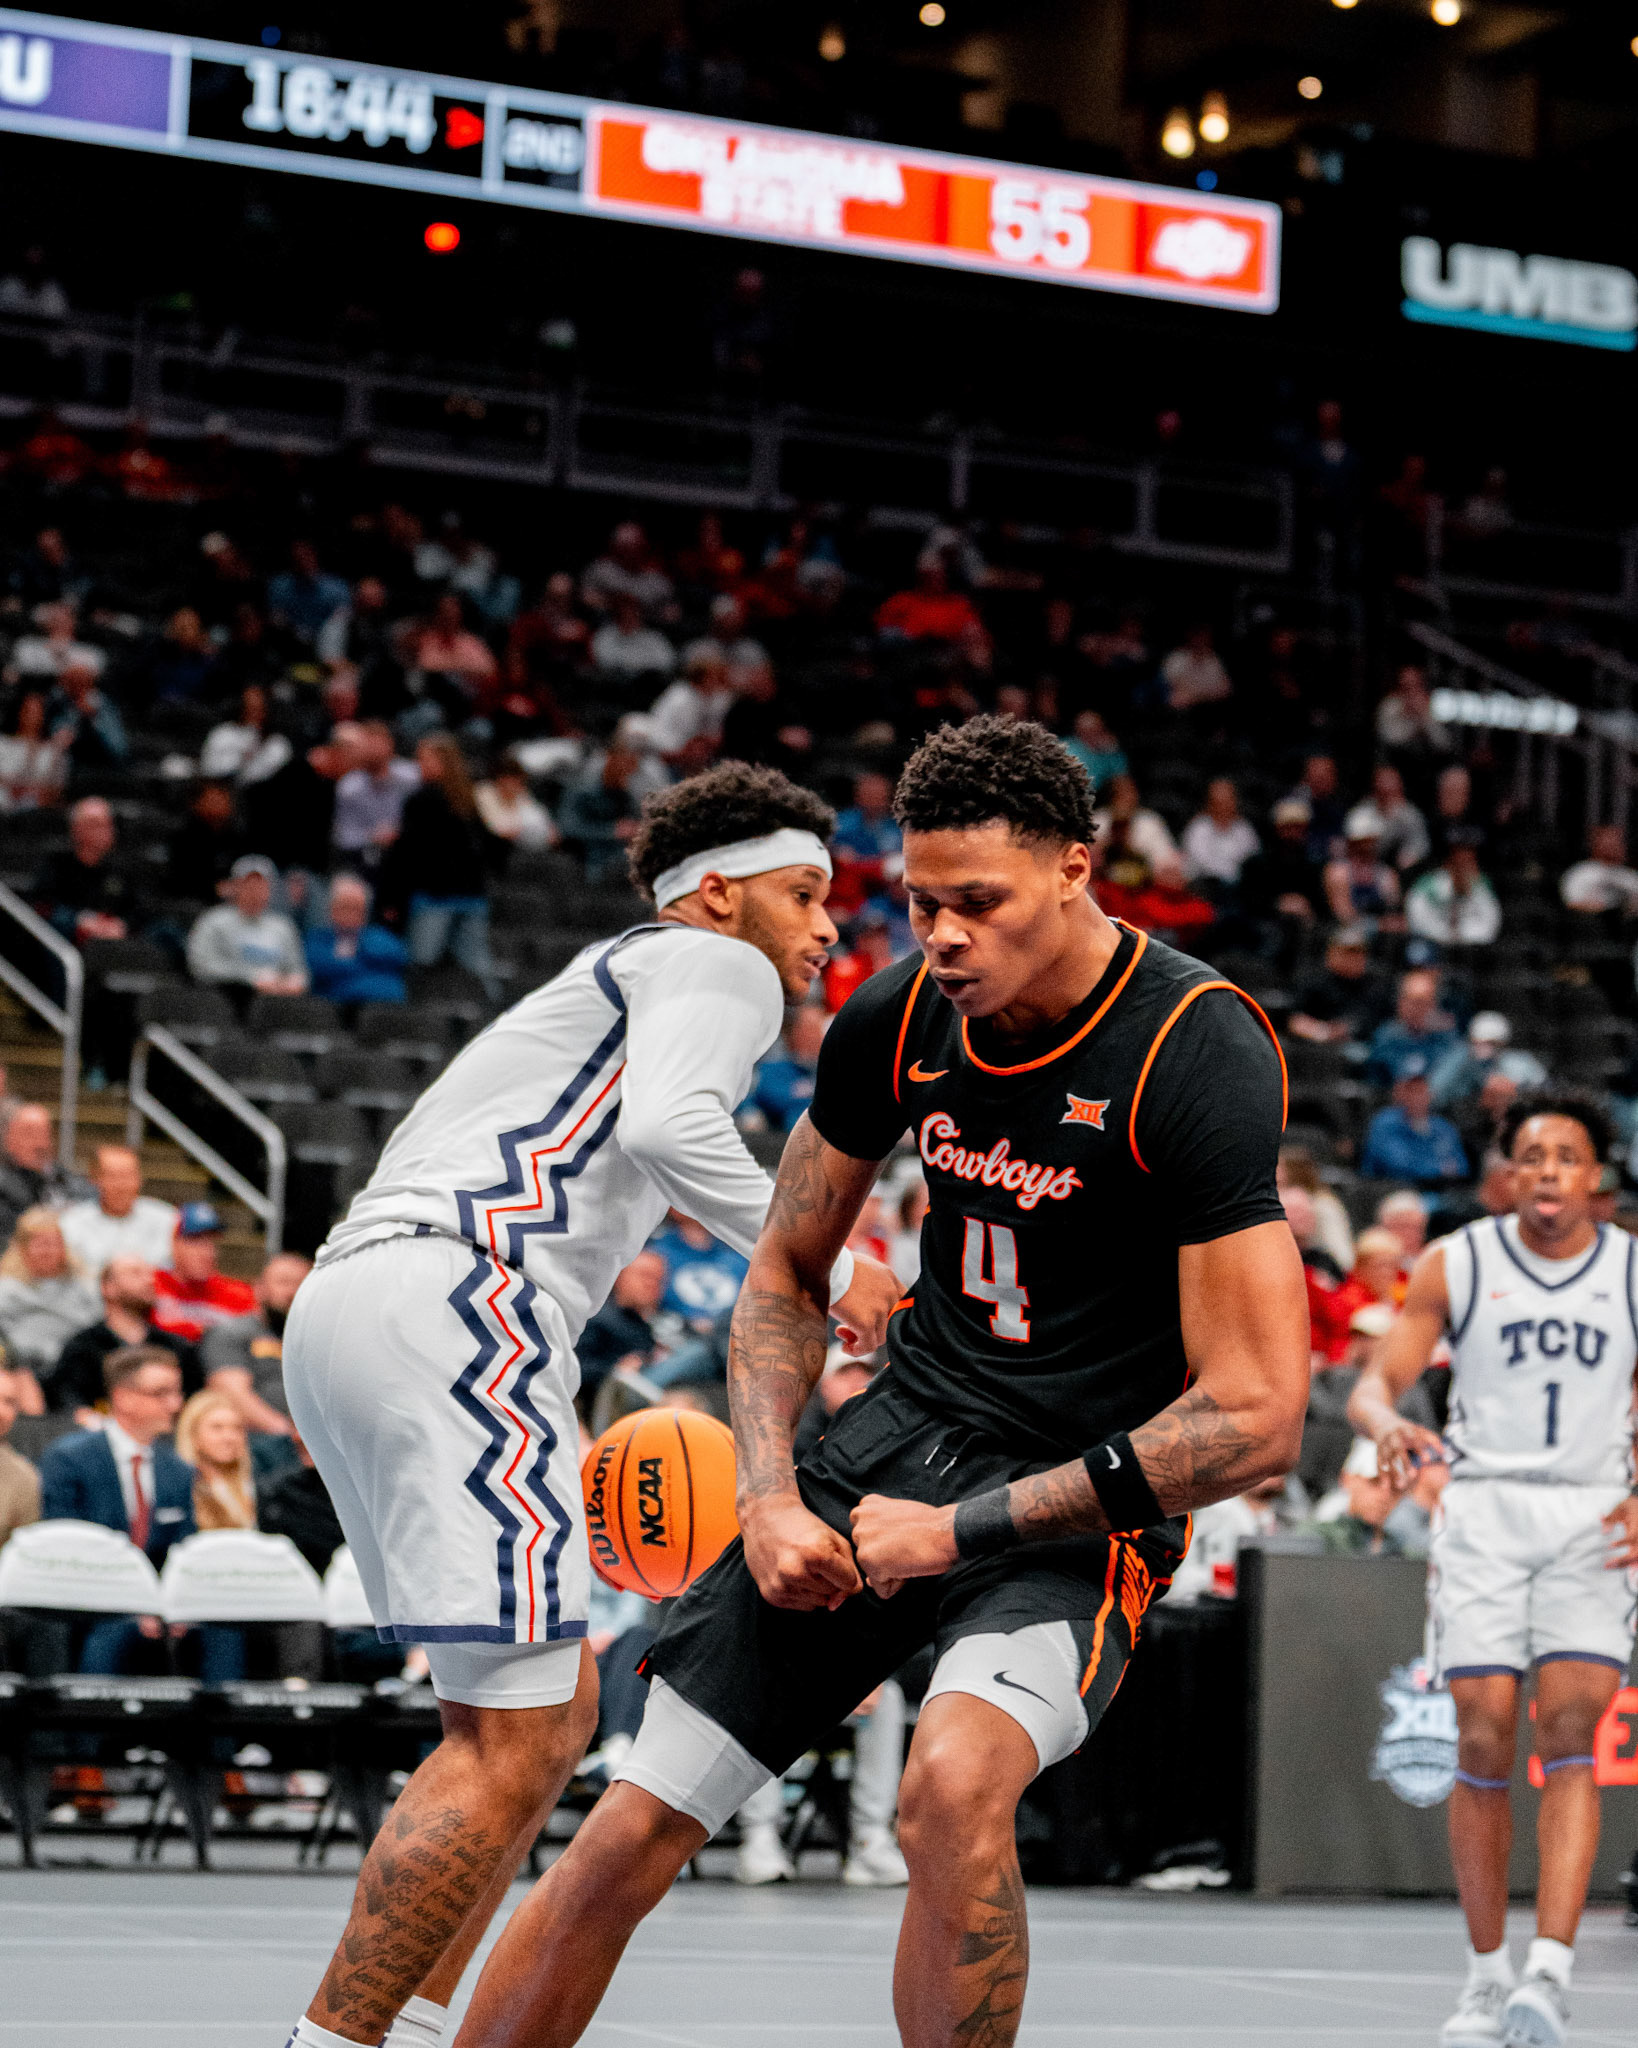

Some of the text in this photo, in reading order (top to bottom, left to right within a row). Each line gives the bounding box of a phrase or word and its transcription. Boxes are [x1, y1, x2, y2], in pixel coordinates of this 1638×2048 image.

[242, 57, 437, 155] 16:44
[991, 178, 1091, 268] 55
[1401, 235, 1637, 332] UMB
[919, 1111, 1083, 1210] Cowboys
[962, 1216, 1030, 1343] 4
[1500, 1319, 1609, 1369] TCU
[1544, 1382, 1560, 1447] 1
[586, 1444, 621, 1567] Wilson
[638, 1458, 667, 1548] NCAA
